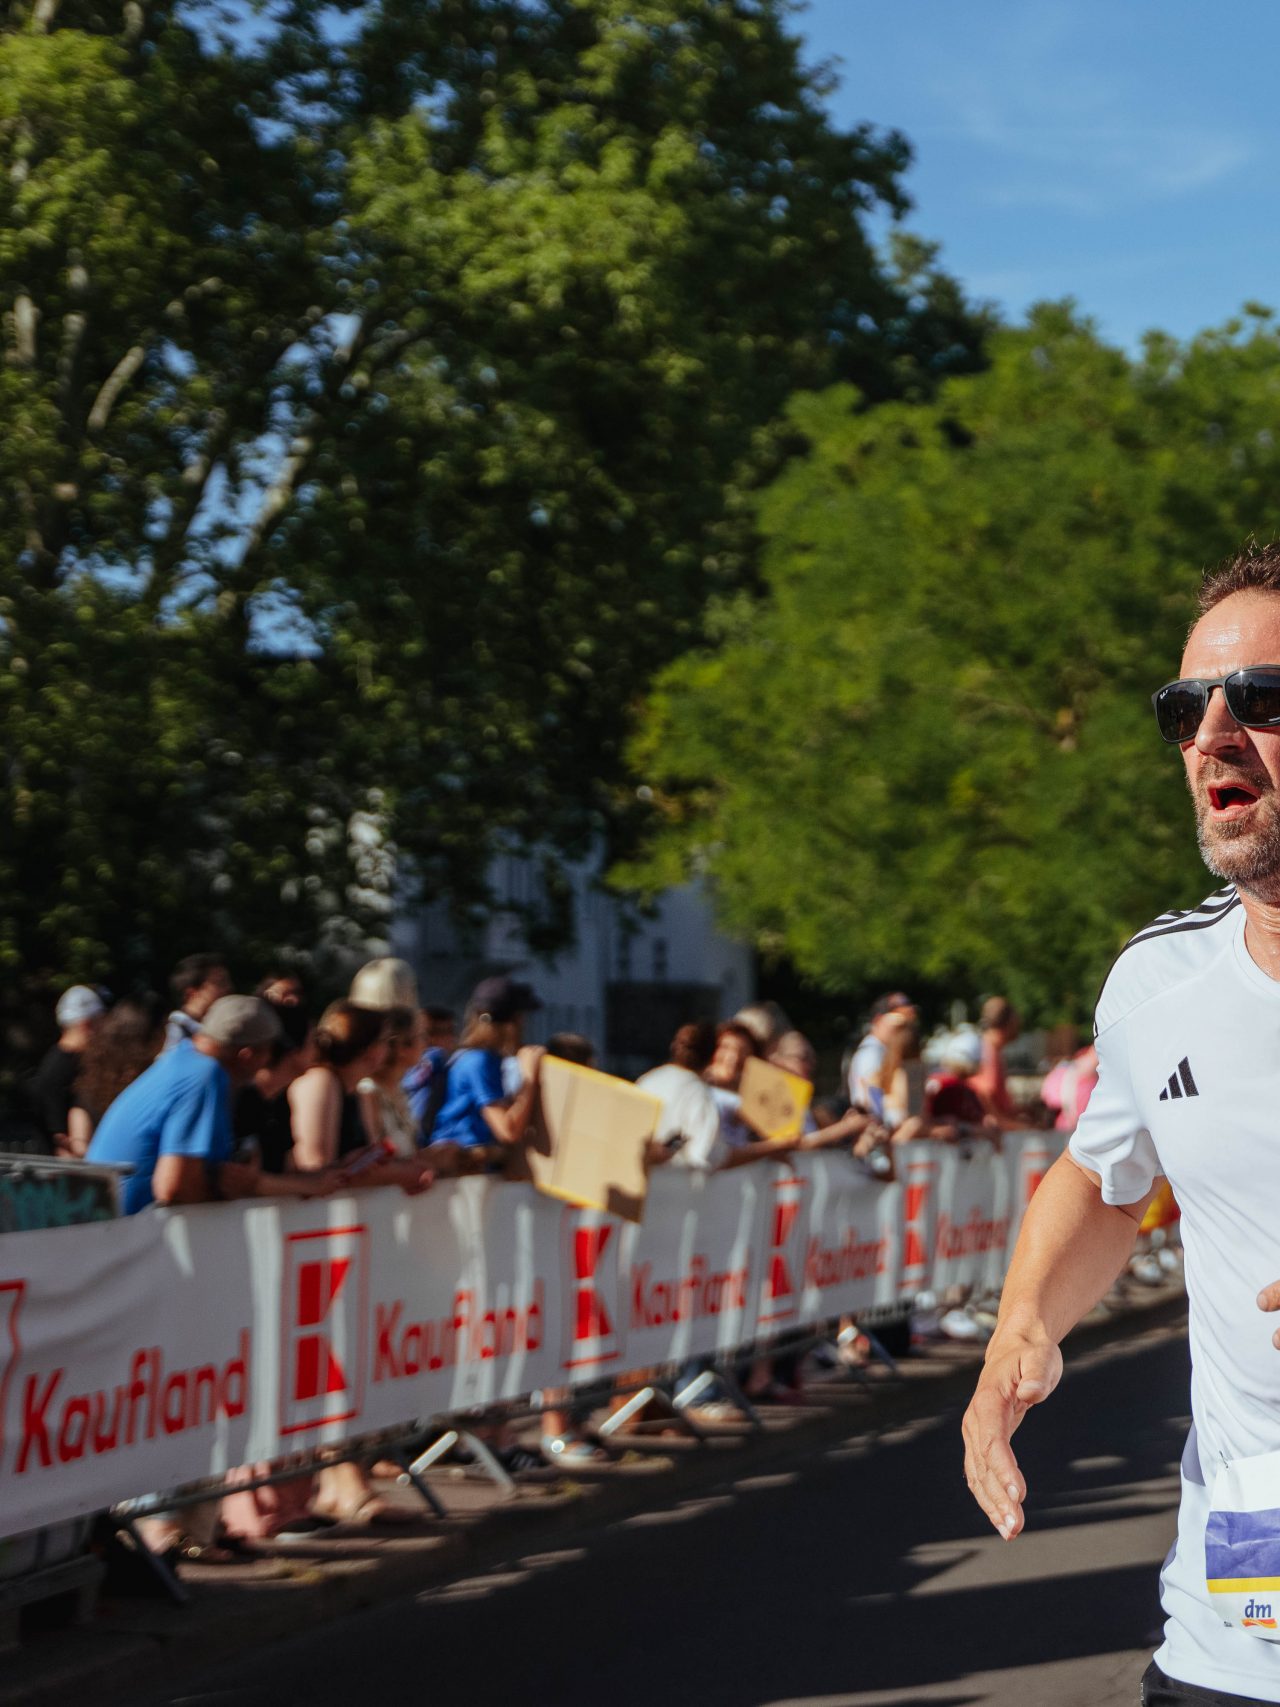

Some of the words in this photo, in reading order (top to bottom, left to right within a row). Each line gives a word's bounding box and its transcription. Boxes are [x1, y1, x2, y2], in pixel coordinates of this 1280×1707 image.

[372, 1279, 545, 1384] Kaufland
[15, 1328, 250, 1475] Kaufland
[1244, 1599, 1272, 1619] dm
